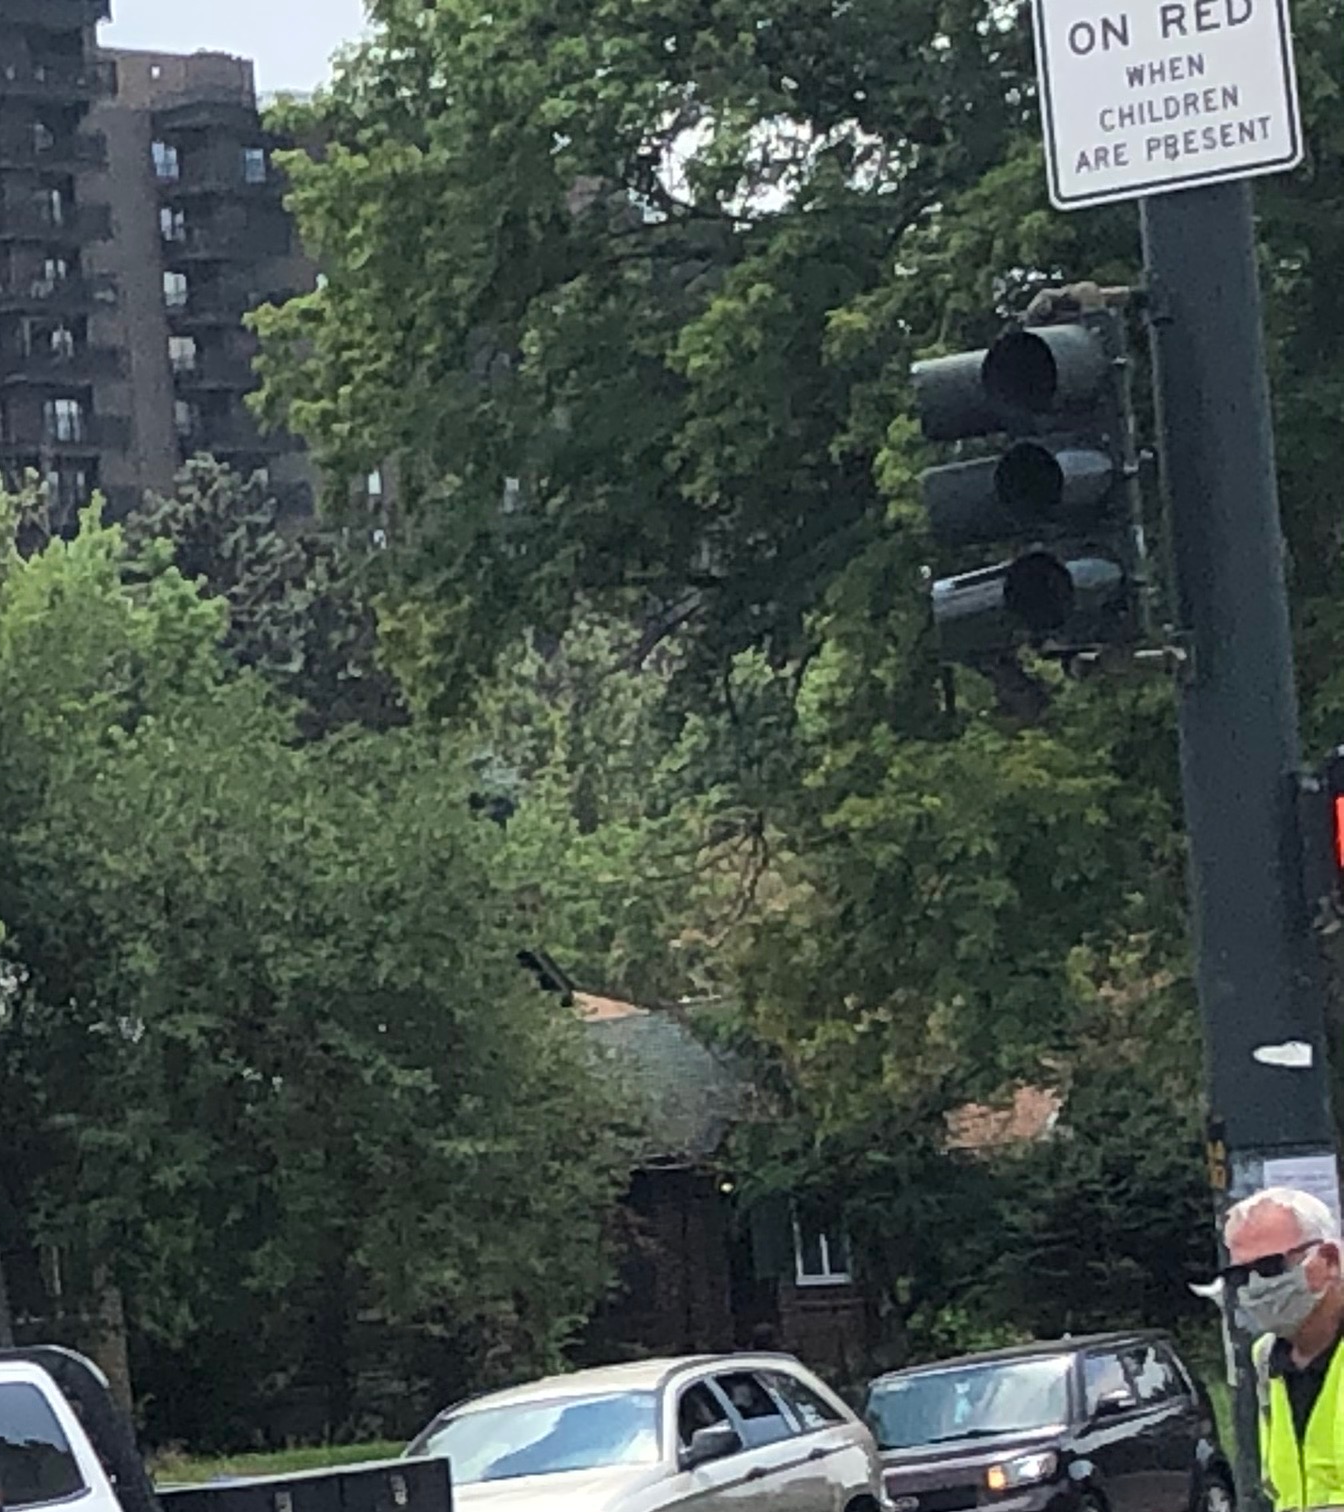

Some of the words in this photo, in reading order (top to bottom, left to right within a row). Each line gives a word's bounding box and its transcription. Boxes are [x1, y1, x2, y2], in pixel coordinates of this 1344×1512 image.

[1068, 14, 1129, 56] ON
[1159, 0, 1253, 38] RED
[1125, 53, 1205, 88] WHEN
[1099, 84, 1239, 132] CHILDREN
[1075, 142, 1129, 174] ARE
[1145, 115, 1272, 162] PRESENT
